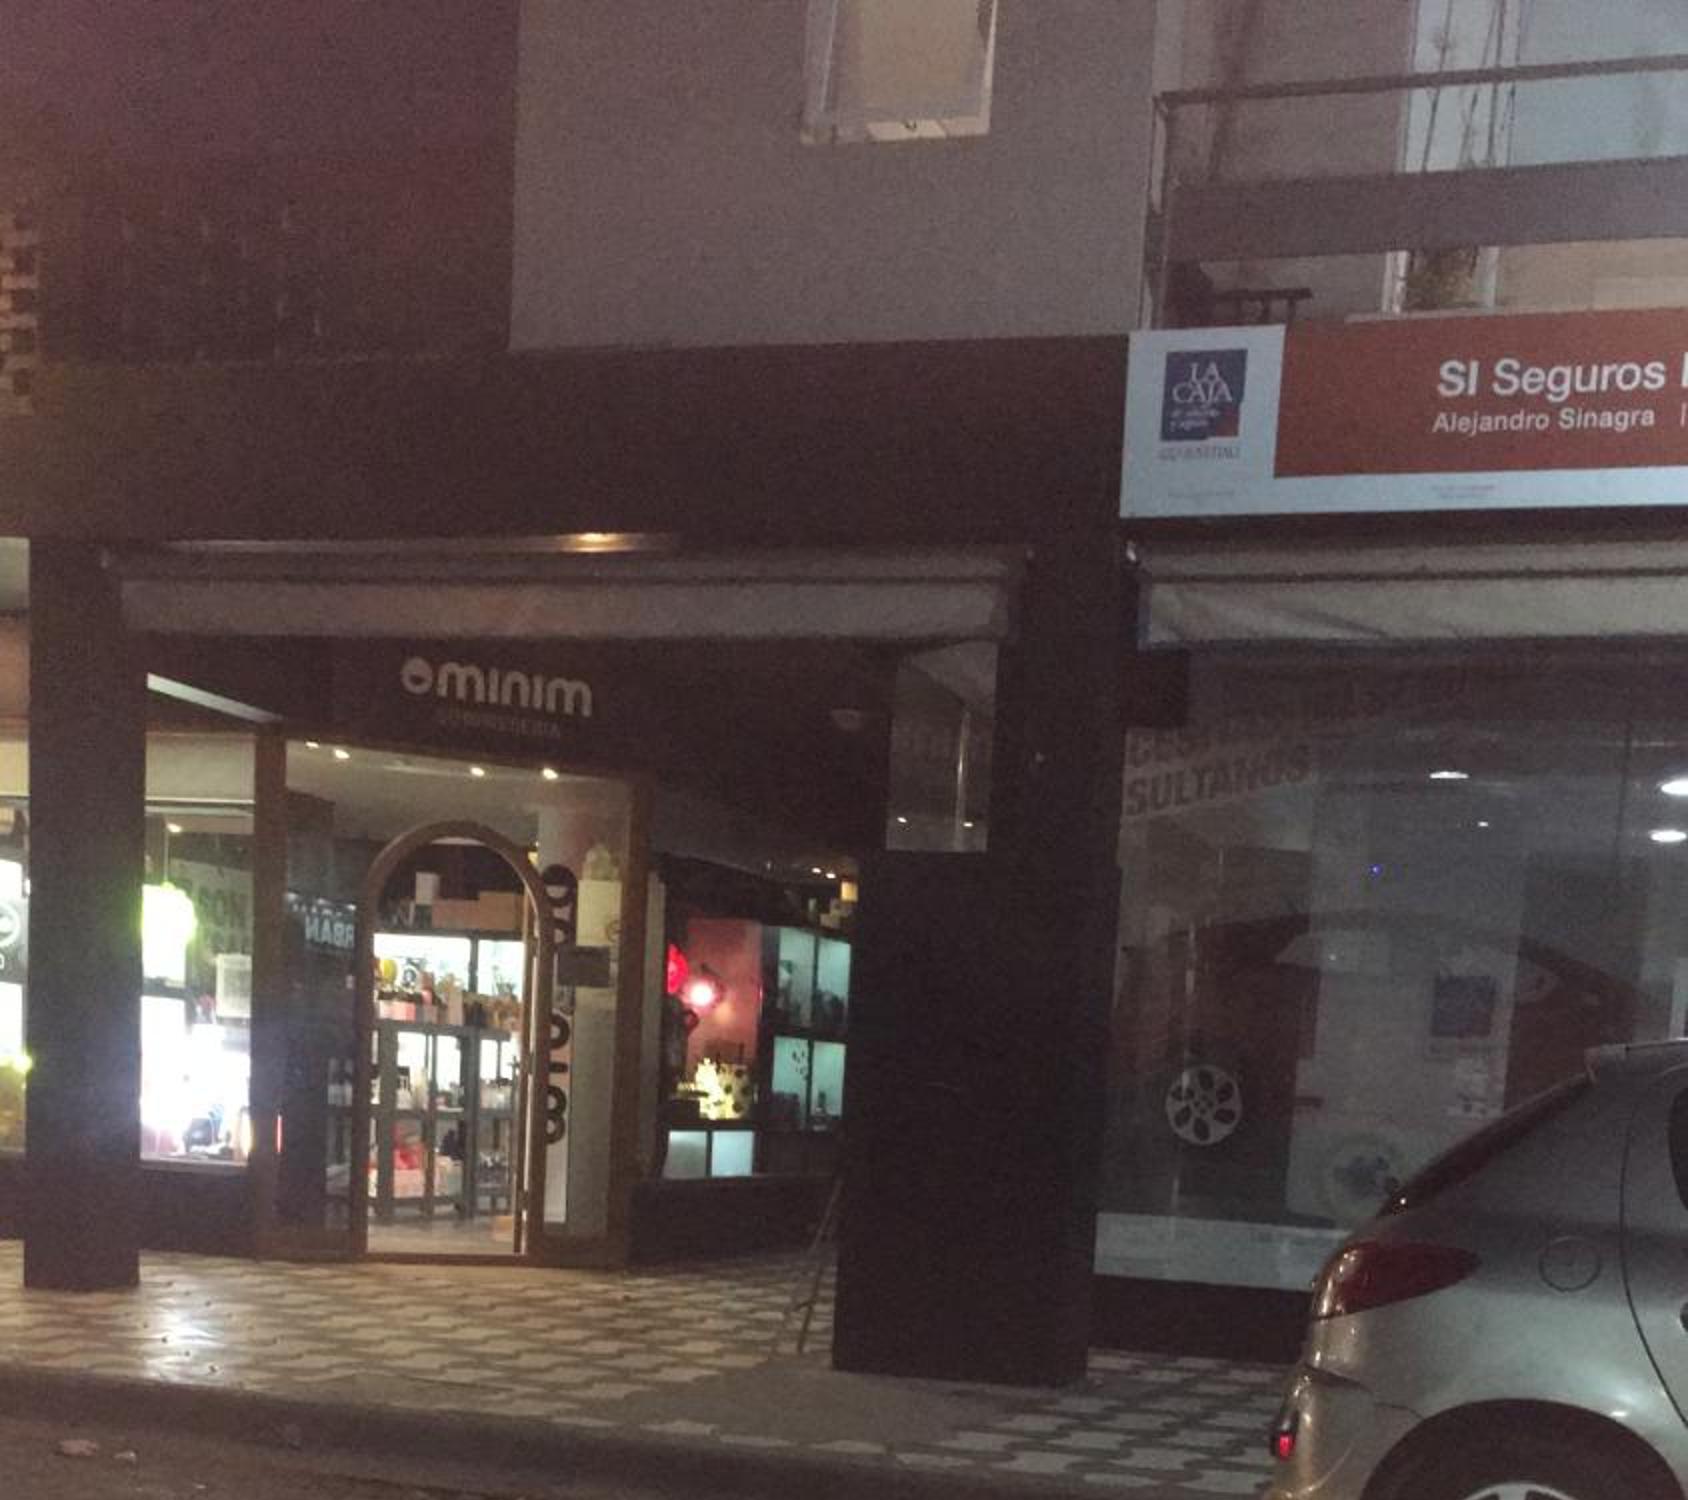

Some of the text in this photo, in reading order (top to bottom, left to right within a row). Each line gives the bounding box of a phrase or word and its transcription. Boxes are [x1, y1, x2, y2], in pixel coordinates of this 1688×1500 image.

[1191, 361, 1221, 382] LA
[1437, 360, 1479, 397] SI
[1493, 358, 1666, 402] Seguros
[1173, 380, 1232, 408] CAJA
[1432, 408, 1550, 436] Alejandro
[1559, 405, 1656, 432] Sinagra
